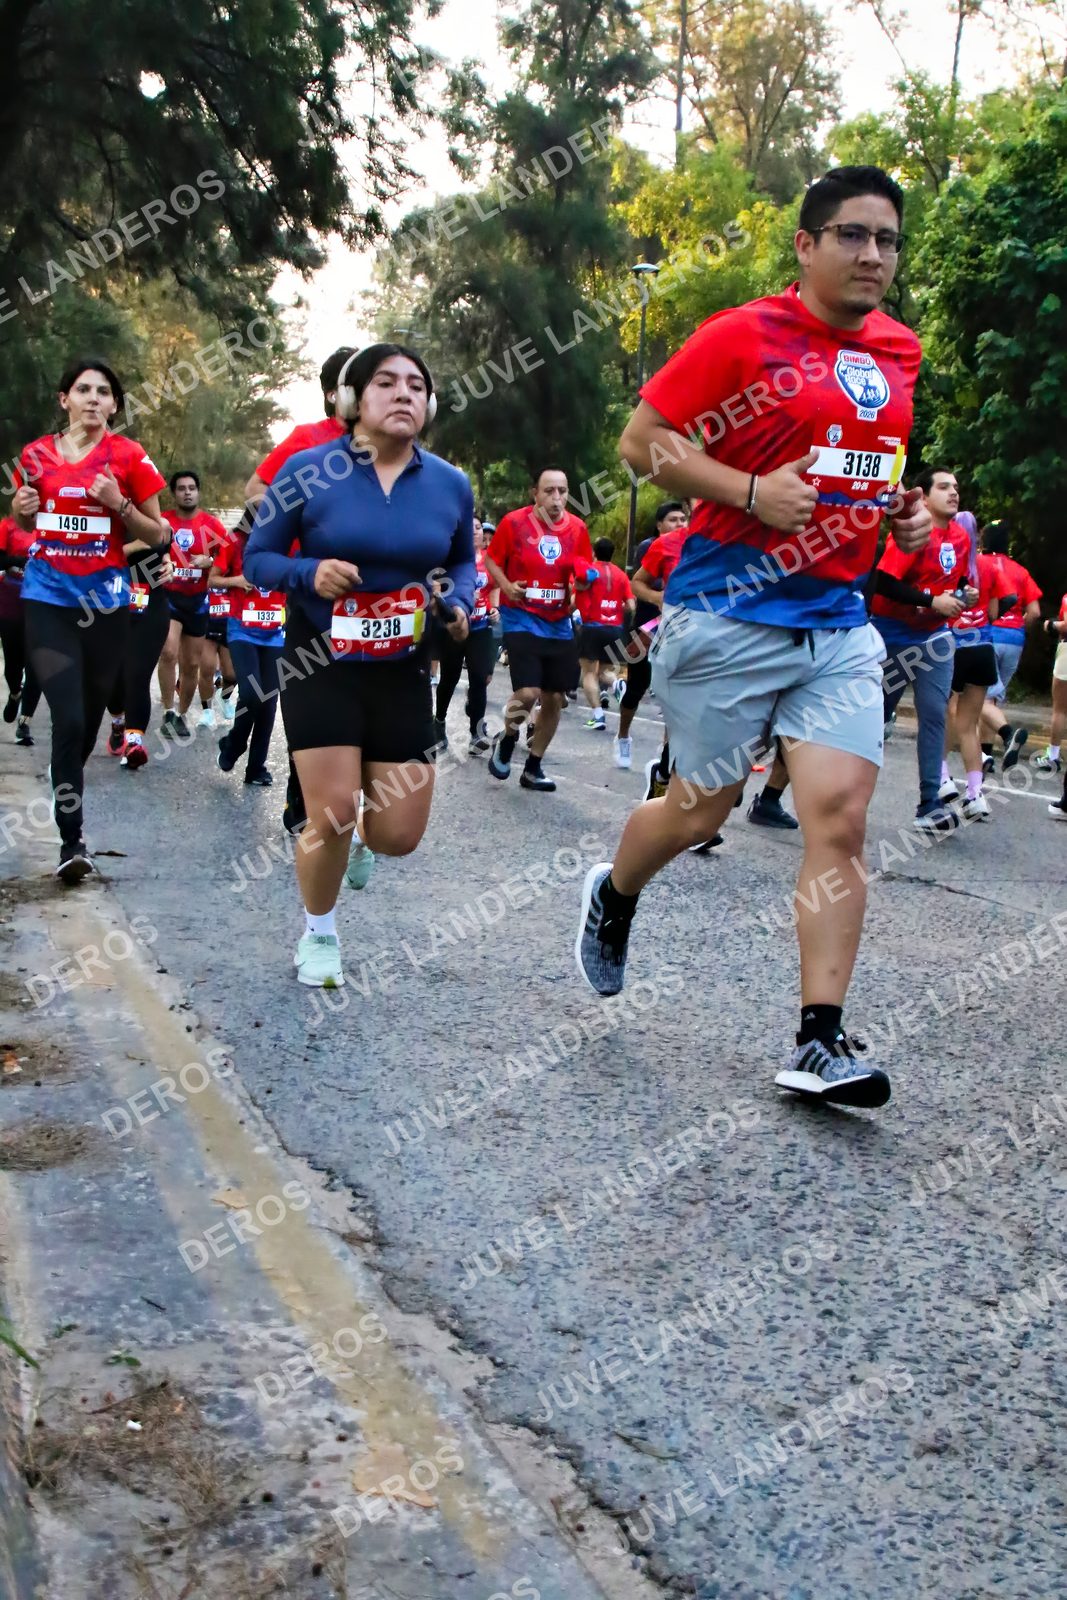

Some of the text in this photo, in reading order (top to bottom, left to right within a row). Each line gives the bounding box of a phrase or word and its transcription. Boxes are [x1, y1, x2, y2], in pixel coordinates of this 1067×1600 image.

[843, 354, 871, 365] BIMBO
[847, 366, 872, 379] Global
[843, 451, 881, 478] 3138
[59, 516, 88, 532] 1490
[257, 611, 276, 621] 1332
[361, 617, 401, 639] 3238
